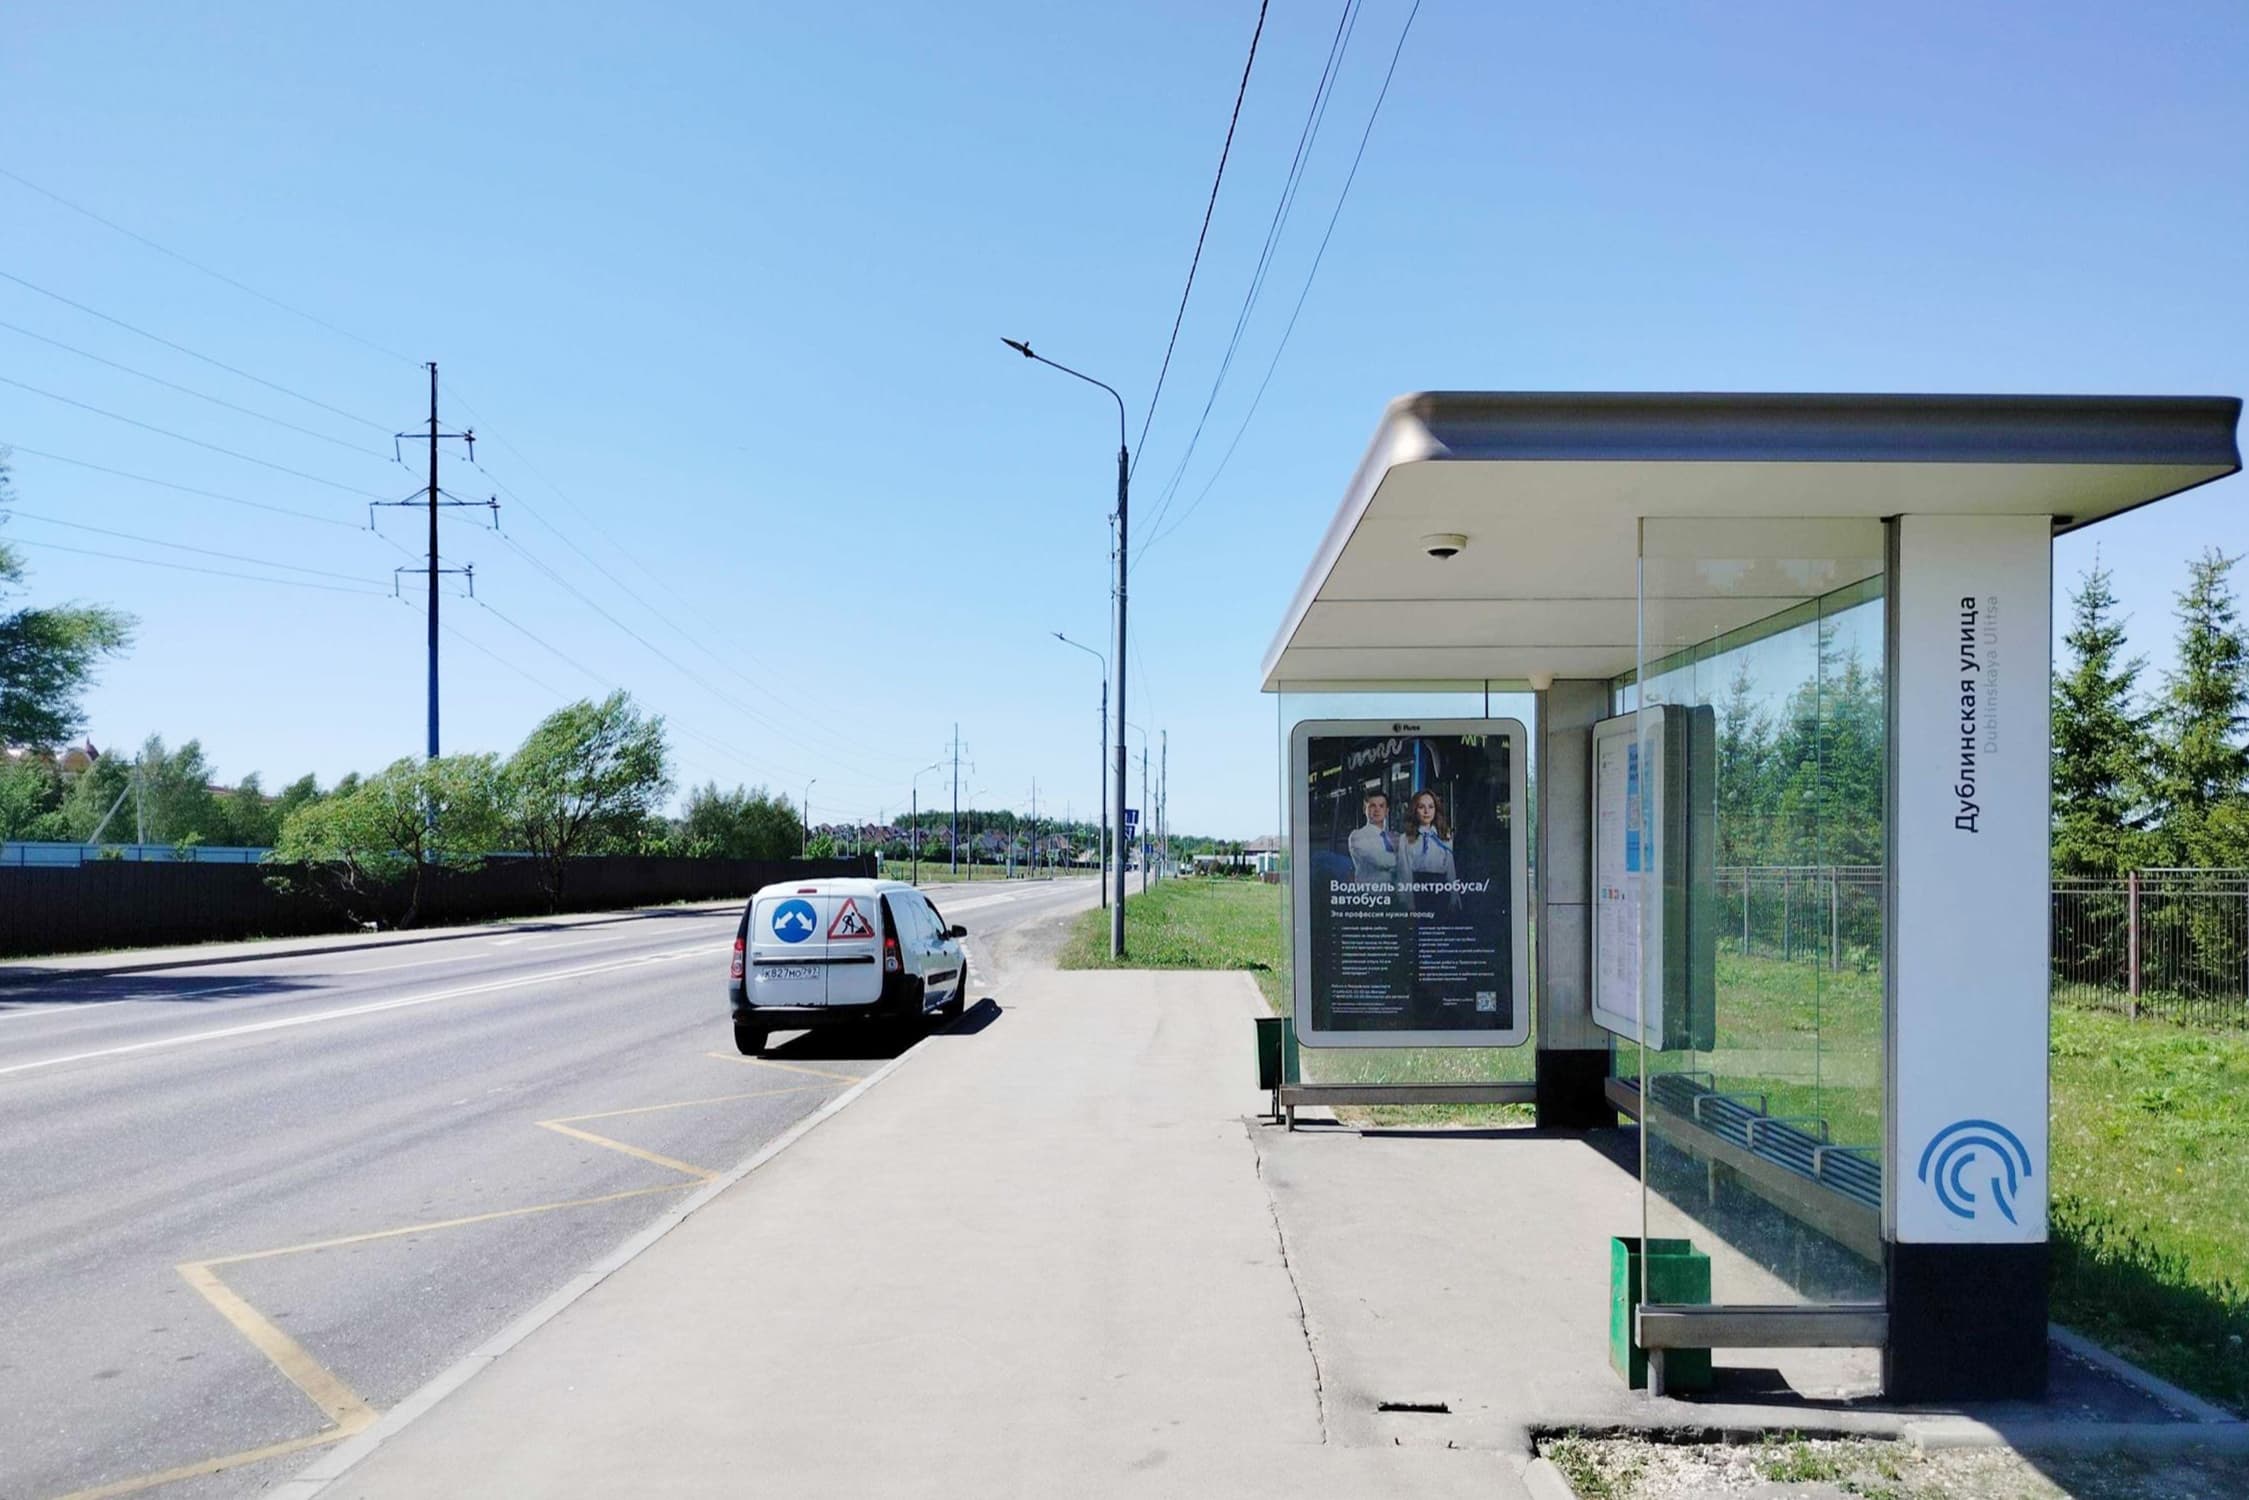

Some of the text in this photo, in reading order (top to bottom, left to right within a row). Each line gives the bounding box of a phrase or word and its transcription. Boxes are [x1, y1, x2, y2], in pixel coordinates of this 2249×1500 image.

[1983, 595, 2000, 754] Dublinskaya Ulitsa
[1955, 596, 1980, 833] Дублинская улица
[1330, 878, 1489, 895] Водитель электробуса/
[1330, 893, 1391, 906] автобуса
[1330, 910, 1343, 918] Эта
[1344, 910, 1384, 919] профессия
[1410, 911, 1435, 919] городу
